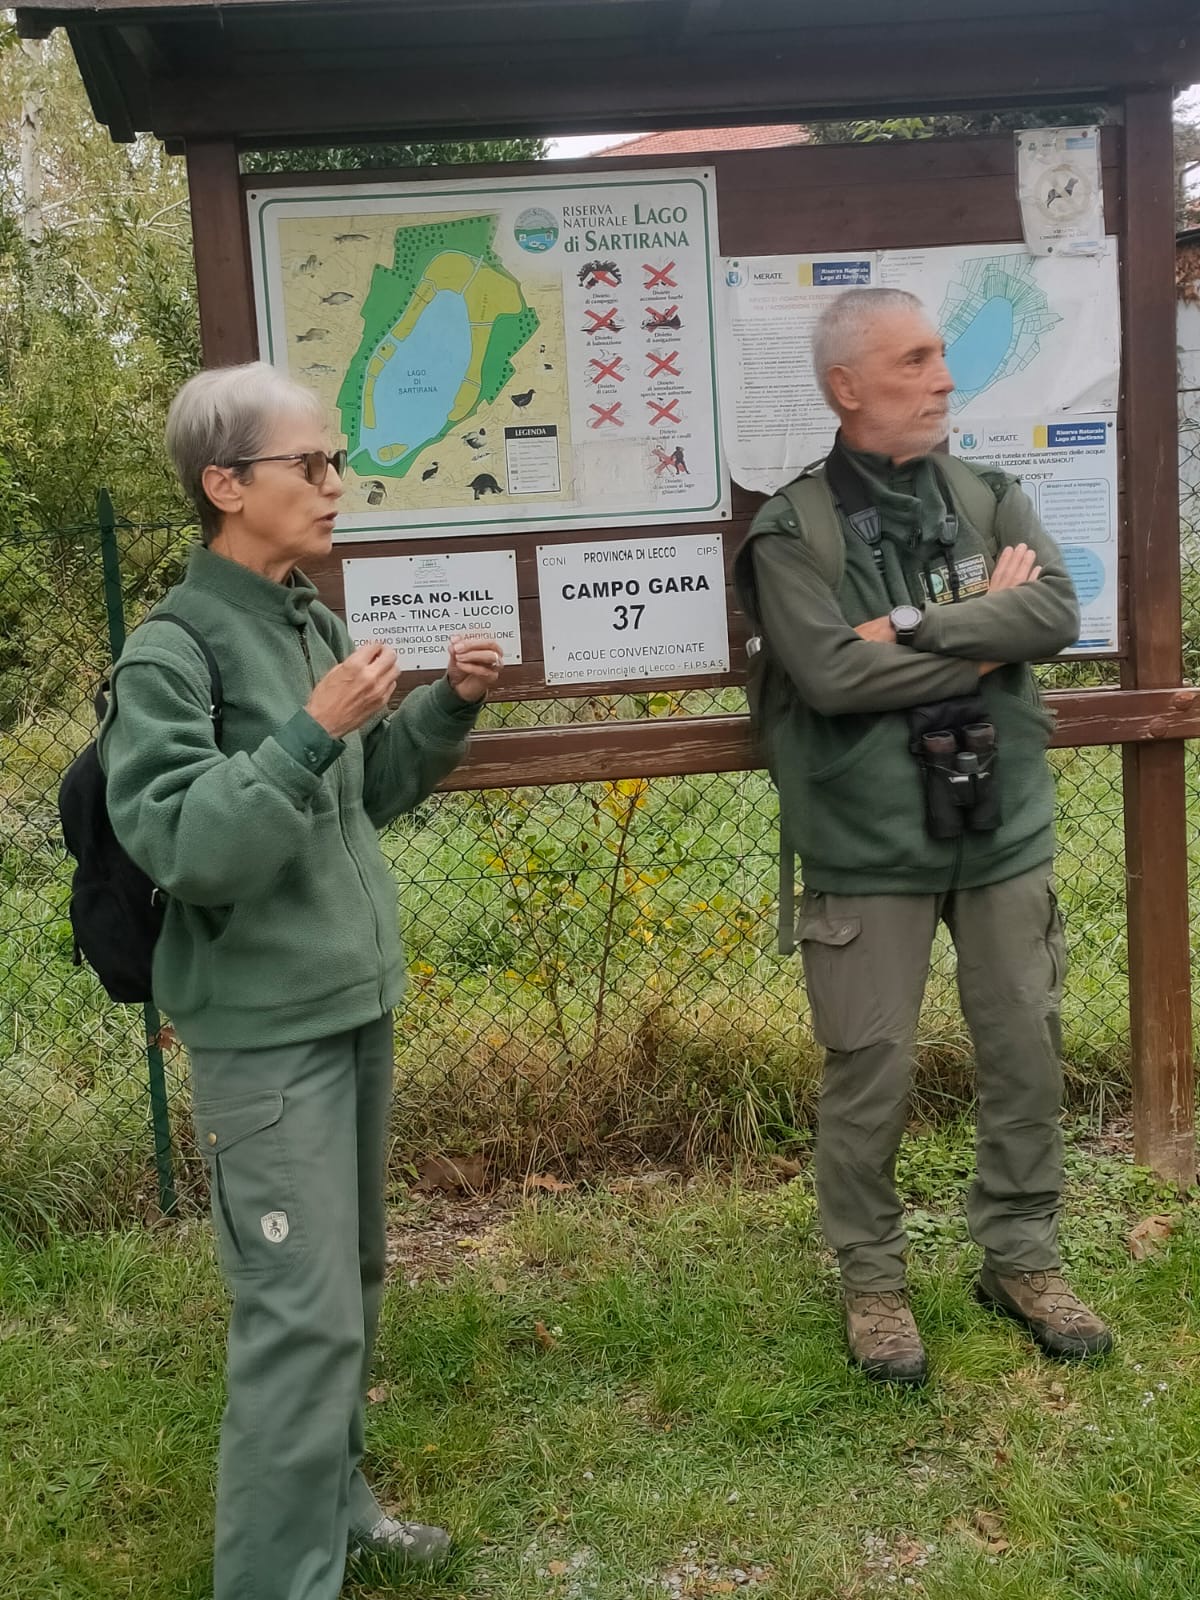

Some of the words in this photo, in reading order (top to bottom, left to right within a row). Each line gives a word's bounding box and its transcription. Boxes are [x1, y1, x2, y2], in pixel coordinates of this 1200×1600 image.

[563, 204, 613, 216] RISERVA
[634, 204, 687, 225] LAGO
[563, 216, 627, 228] NATURALE
[564, 237, 579, 253] di
[585, 231, 689, 251] SARTIRANA
[399, 386, 438, 395] SARTIRANA
[515, 428, 546, 436] LEGENDA
[584, 549, 634, 563] PROVINCIA
[636, 549, 645, 560] DI
[648, 546, 676, 559] LECCO
[697, 547, 718, 556] CIPS
[543, 557, 566, 566] CONI
[562, 580, 640, 600] CAMPO
[649, 575, 710, 594] GARA
[370, 593, 424, 606] PESCA
[430, 590, 493, 603] NO-KILL
[351, 612, 397, 623] CARPA
[410, 609, 450, 620] TINCA
[463, 605, 513, 617] LUCCIO
[613, 604, 645, 630] 37
[373, 625, 425, 635] CONSENTITA
[427, 624, 438, 632] LA
[440, 623, 466, 631] PESCA
[395, 635, 432, 644] SINGOLO
[568, 649, 606, 661] ACQUE
[610, 642, 705, 659] CONVENZIONATE
[549, 667, 584, 679] Sezione
[587, 666, 635, 677] Provinciale
[639, 664, 646, 673] di
[649, 663, 676, 672] Lecco
